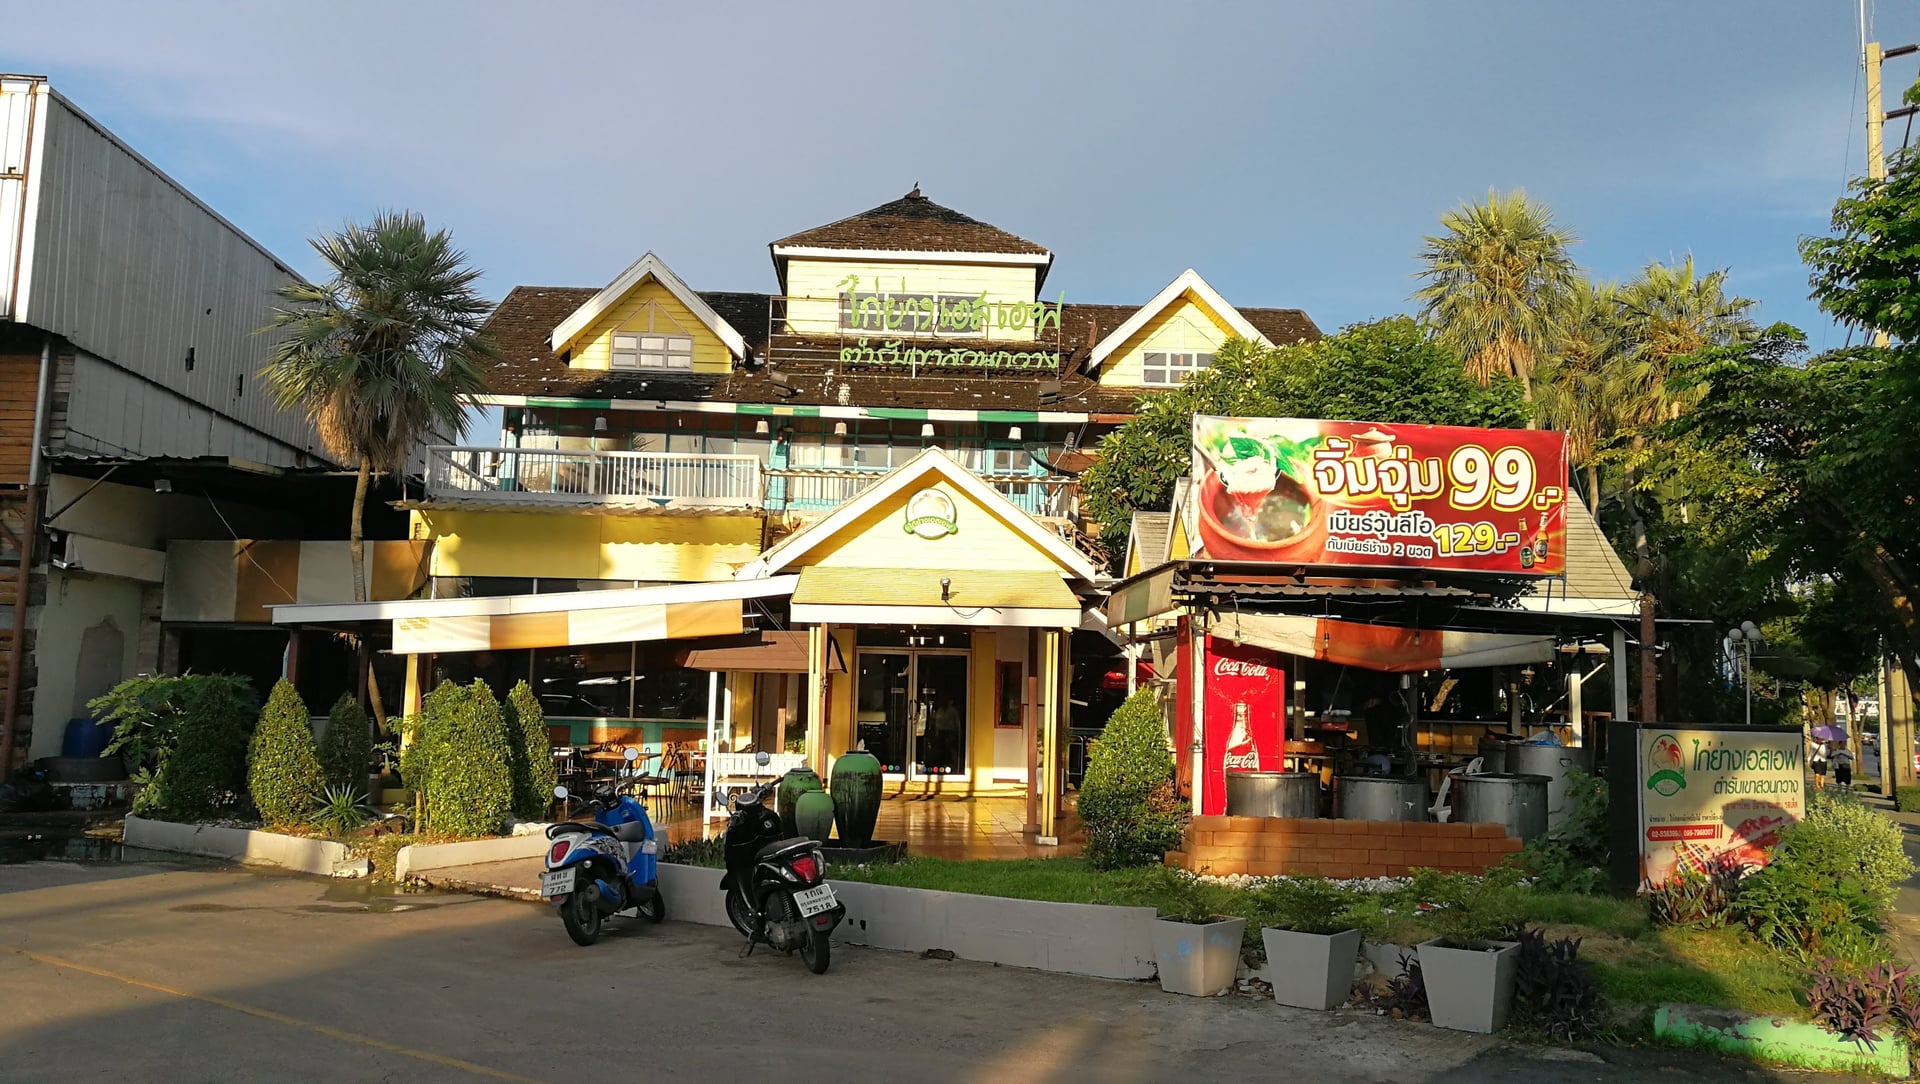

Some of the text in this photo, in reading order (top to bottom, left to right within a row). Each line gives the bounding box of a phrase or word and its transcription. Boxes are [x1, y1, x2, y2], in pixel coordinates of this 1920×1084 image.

[1313, 437, 1443, 511] จิ้มจุ่ม
[1328, 511, 1433, 538] เบียร์วุ้นลีโอ
[1327, 538, 1432, 558] กับเบียร์ช้าง 2 ขวด
[1692, 738, 1799, 771] ไก่ย่างเอสเอฟ
[1714, 776, 1799, 795] ตำรับเขาสวนกวาง
